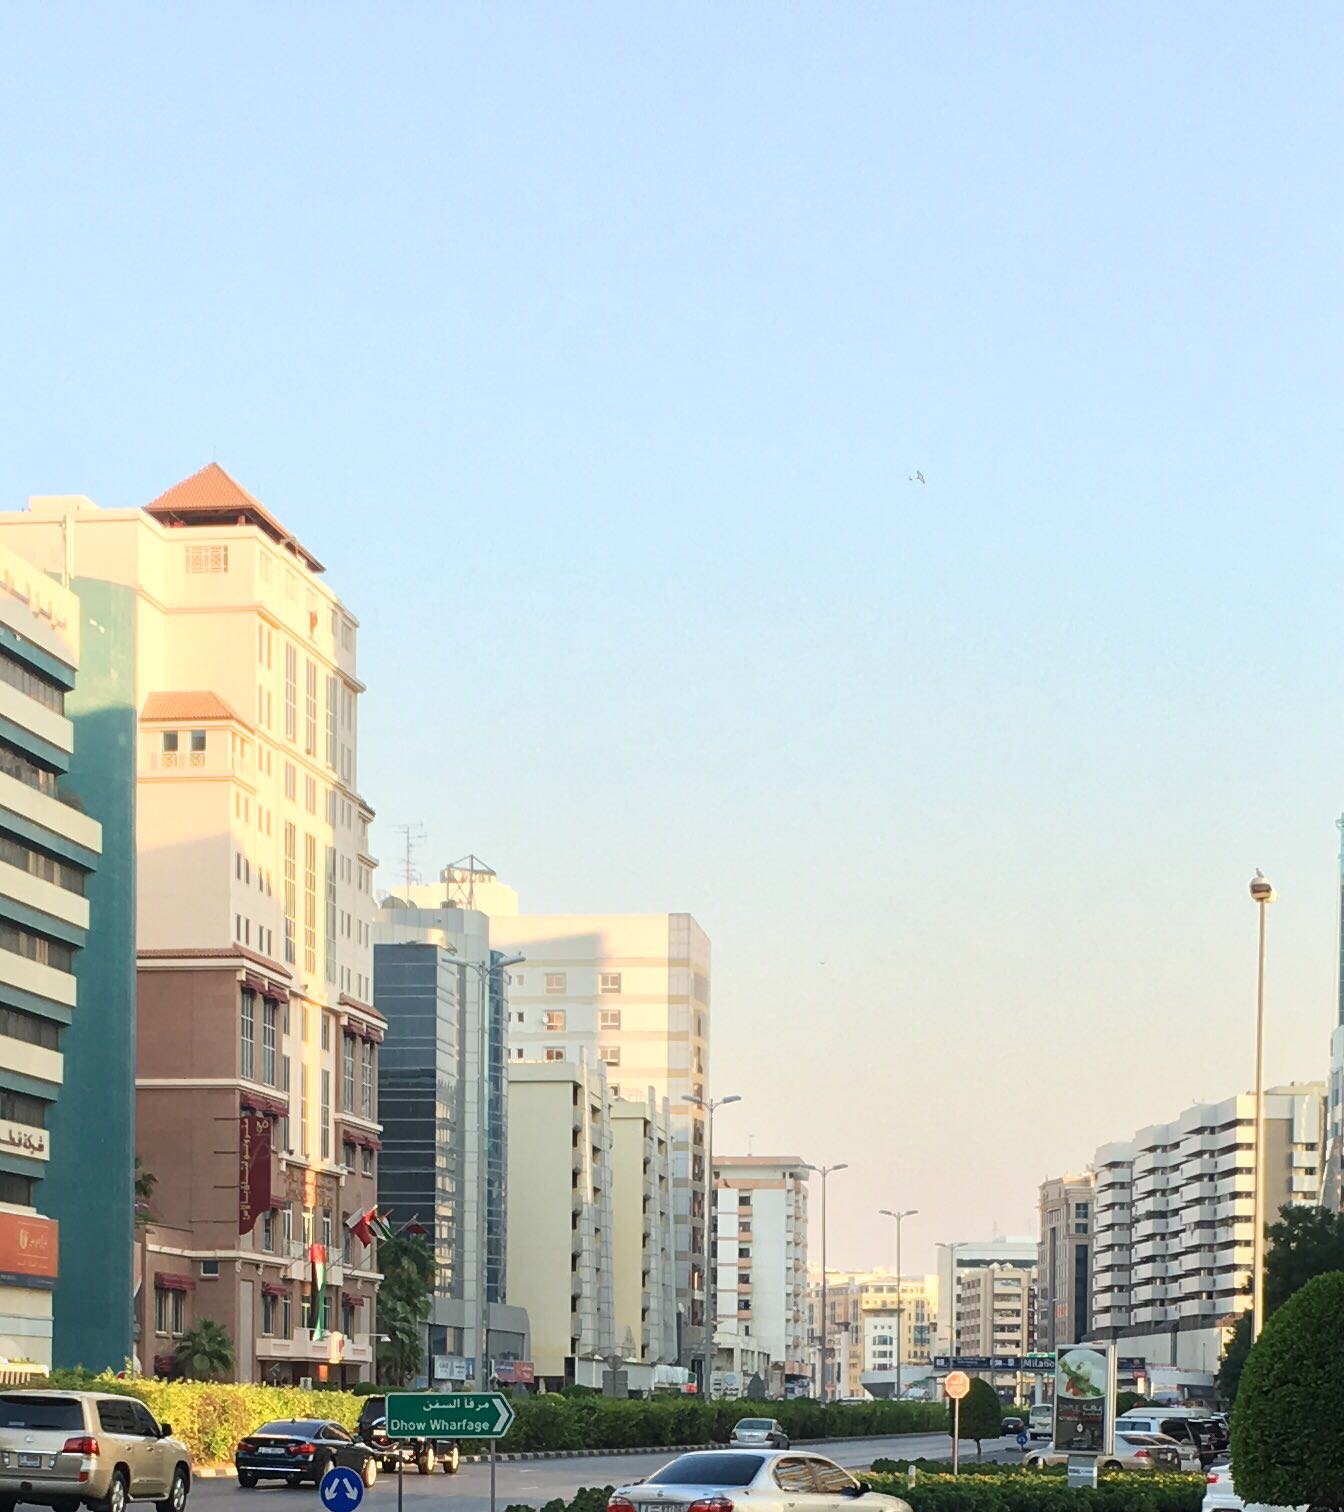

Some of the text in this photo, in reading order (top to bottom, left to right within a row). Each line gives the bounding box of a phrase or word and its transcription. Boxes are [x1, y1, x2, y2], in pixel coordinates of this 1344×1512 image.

[422, 1397, 491, 1412] مرفأ السفن
[390, 1418, 490, 1433] Dhow Wharfage
